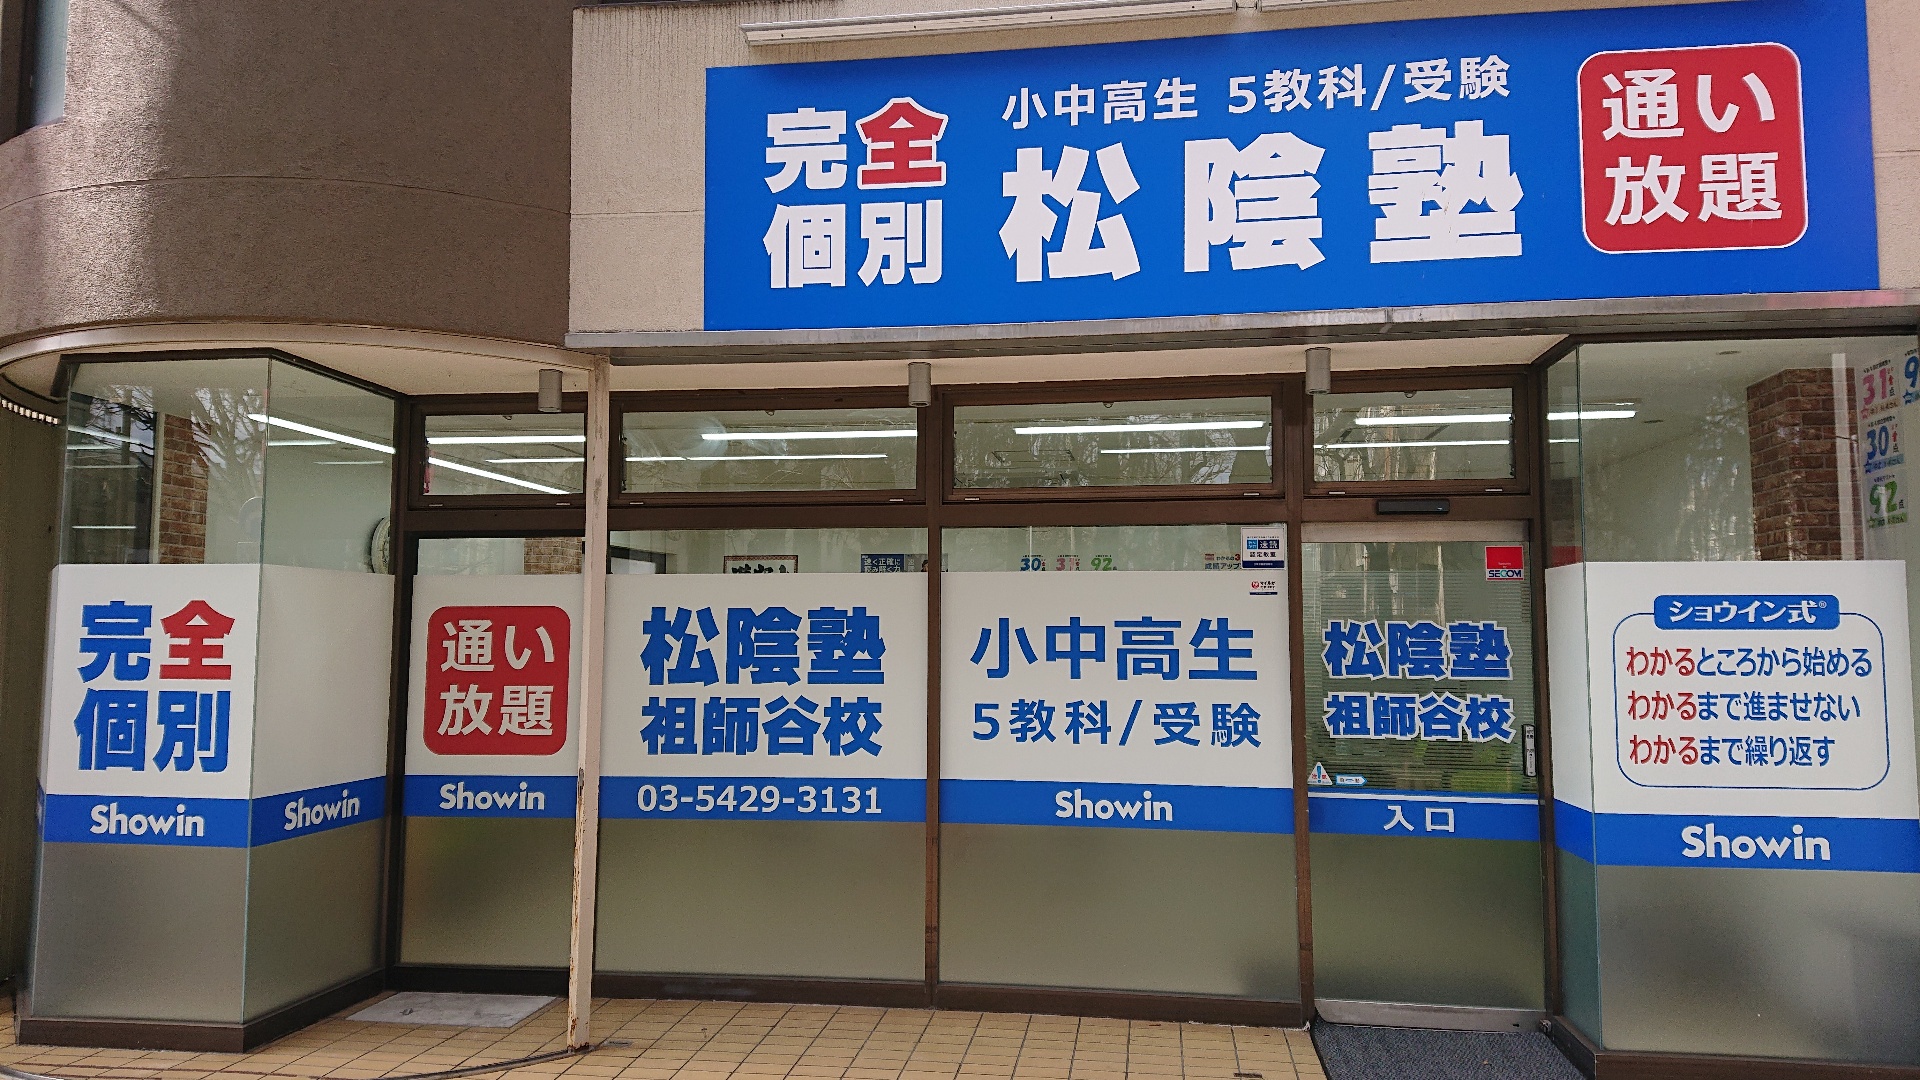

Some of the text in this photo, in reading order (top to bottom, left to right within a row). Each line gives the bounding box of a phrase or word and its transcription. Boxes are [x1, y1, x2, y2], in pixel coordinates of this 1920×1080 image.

[1002, 54, 1511, 130] 小中高生 5教科/受験
[1602, 69, 1776, 142] 通い
[764, 97, 948, 193] 完全
[999, 119, 1524, 283] 松陰塾
[1604, 151, 1783, 227] 放題
[763, 200, 943, 288] 個別
[1866, 425, 1890, 460] 30
[1488, 569, 1522, 578] SECOM
[77, 600, 235, 683] 完全
[441, 619, 554, 674] 通い
[640, 606, 887, 687] 松陰塾
[970, 616, 1259, 681] 小中高生
[1322, 619, 1514, 680] 松陰塾
[1626, 646, 1873, 678] わかるところから始める
[74, 687, 231, 773] 個別
[437, 684, 554, 737] 放題
[640, 695, 884, 757] 祖師谷校
[972, 698, 1262, 748] 5教科/受験
[1322, 691, 1516, 743] 祖師谷校
[1627, 690, 1861, 722] わかるまで進ませない
[1629, 734, 1836, 767] わかるまで繰り返す
[90, 802, 205, 838] Showin
[284, 789, 360, 830] Showin
[439, 782, 546, 811] Showin
[637, 785, 882, 815] 03-5429-3131
[1055, 789, 1173, 822] Showin
[1383, 805, 1455, 832] 入口
[1681, 823, 1831, 861] Showin
